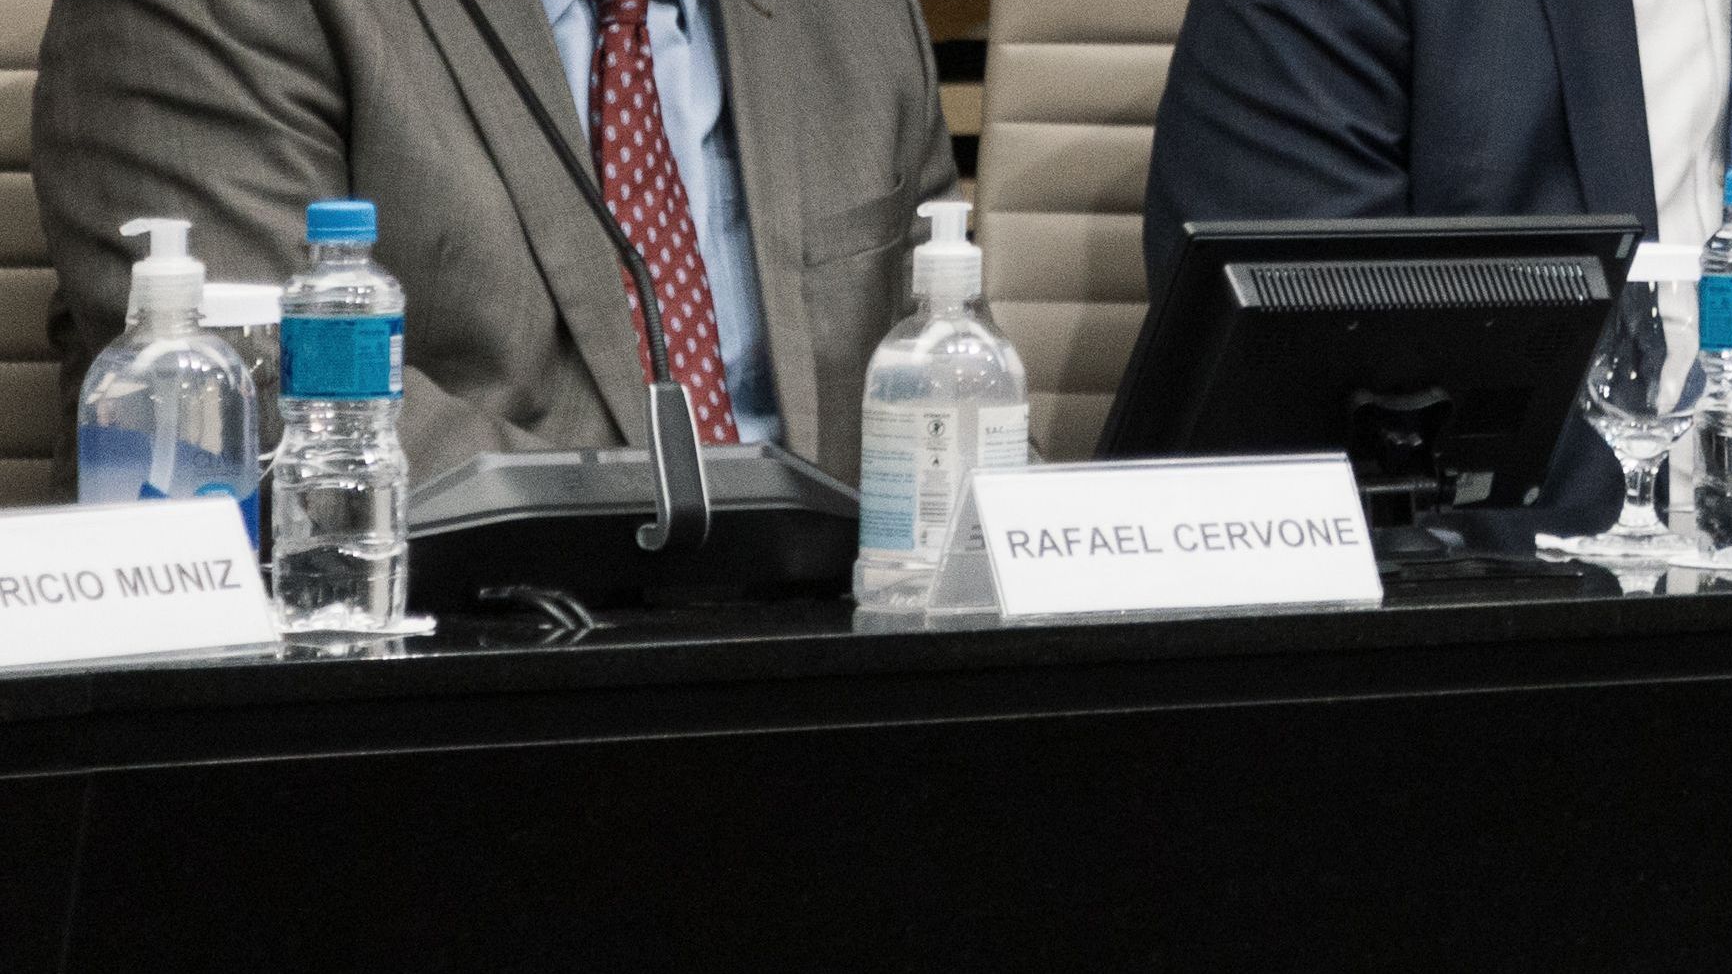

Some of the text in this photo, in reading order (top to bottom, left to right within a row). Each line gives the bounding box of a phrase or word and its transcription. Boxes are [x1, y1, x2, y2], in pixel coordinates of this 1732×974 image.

[1006, 526, 1163, 559] RAFAEL
[1173, 517, 1360, 554] CERVONE
[0, 559, 241, 608] RICIO MUNIZ
